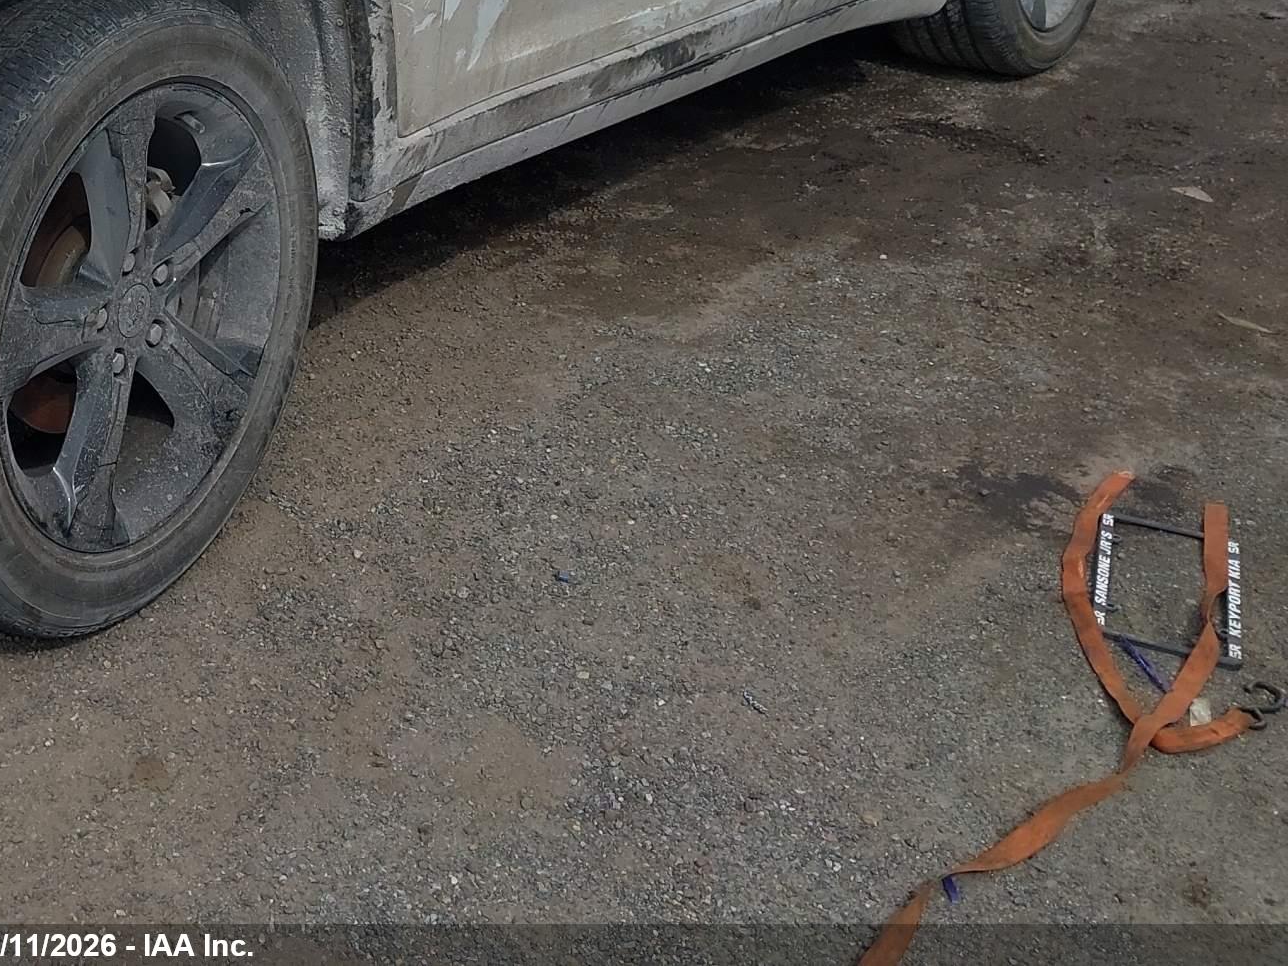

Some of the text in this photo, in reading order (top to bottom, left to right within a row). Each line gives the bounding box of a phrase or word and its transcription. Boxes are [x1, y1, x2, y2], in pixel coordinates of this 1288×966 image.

[1100, 530, 1113, 555] JR'S
[1094, 554, 1112, 606] SANSONE
[1227, 559, 1241, 580] KIA
[1227, 579, 1242, 638] KEYPORT
